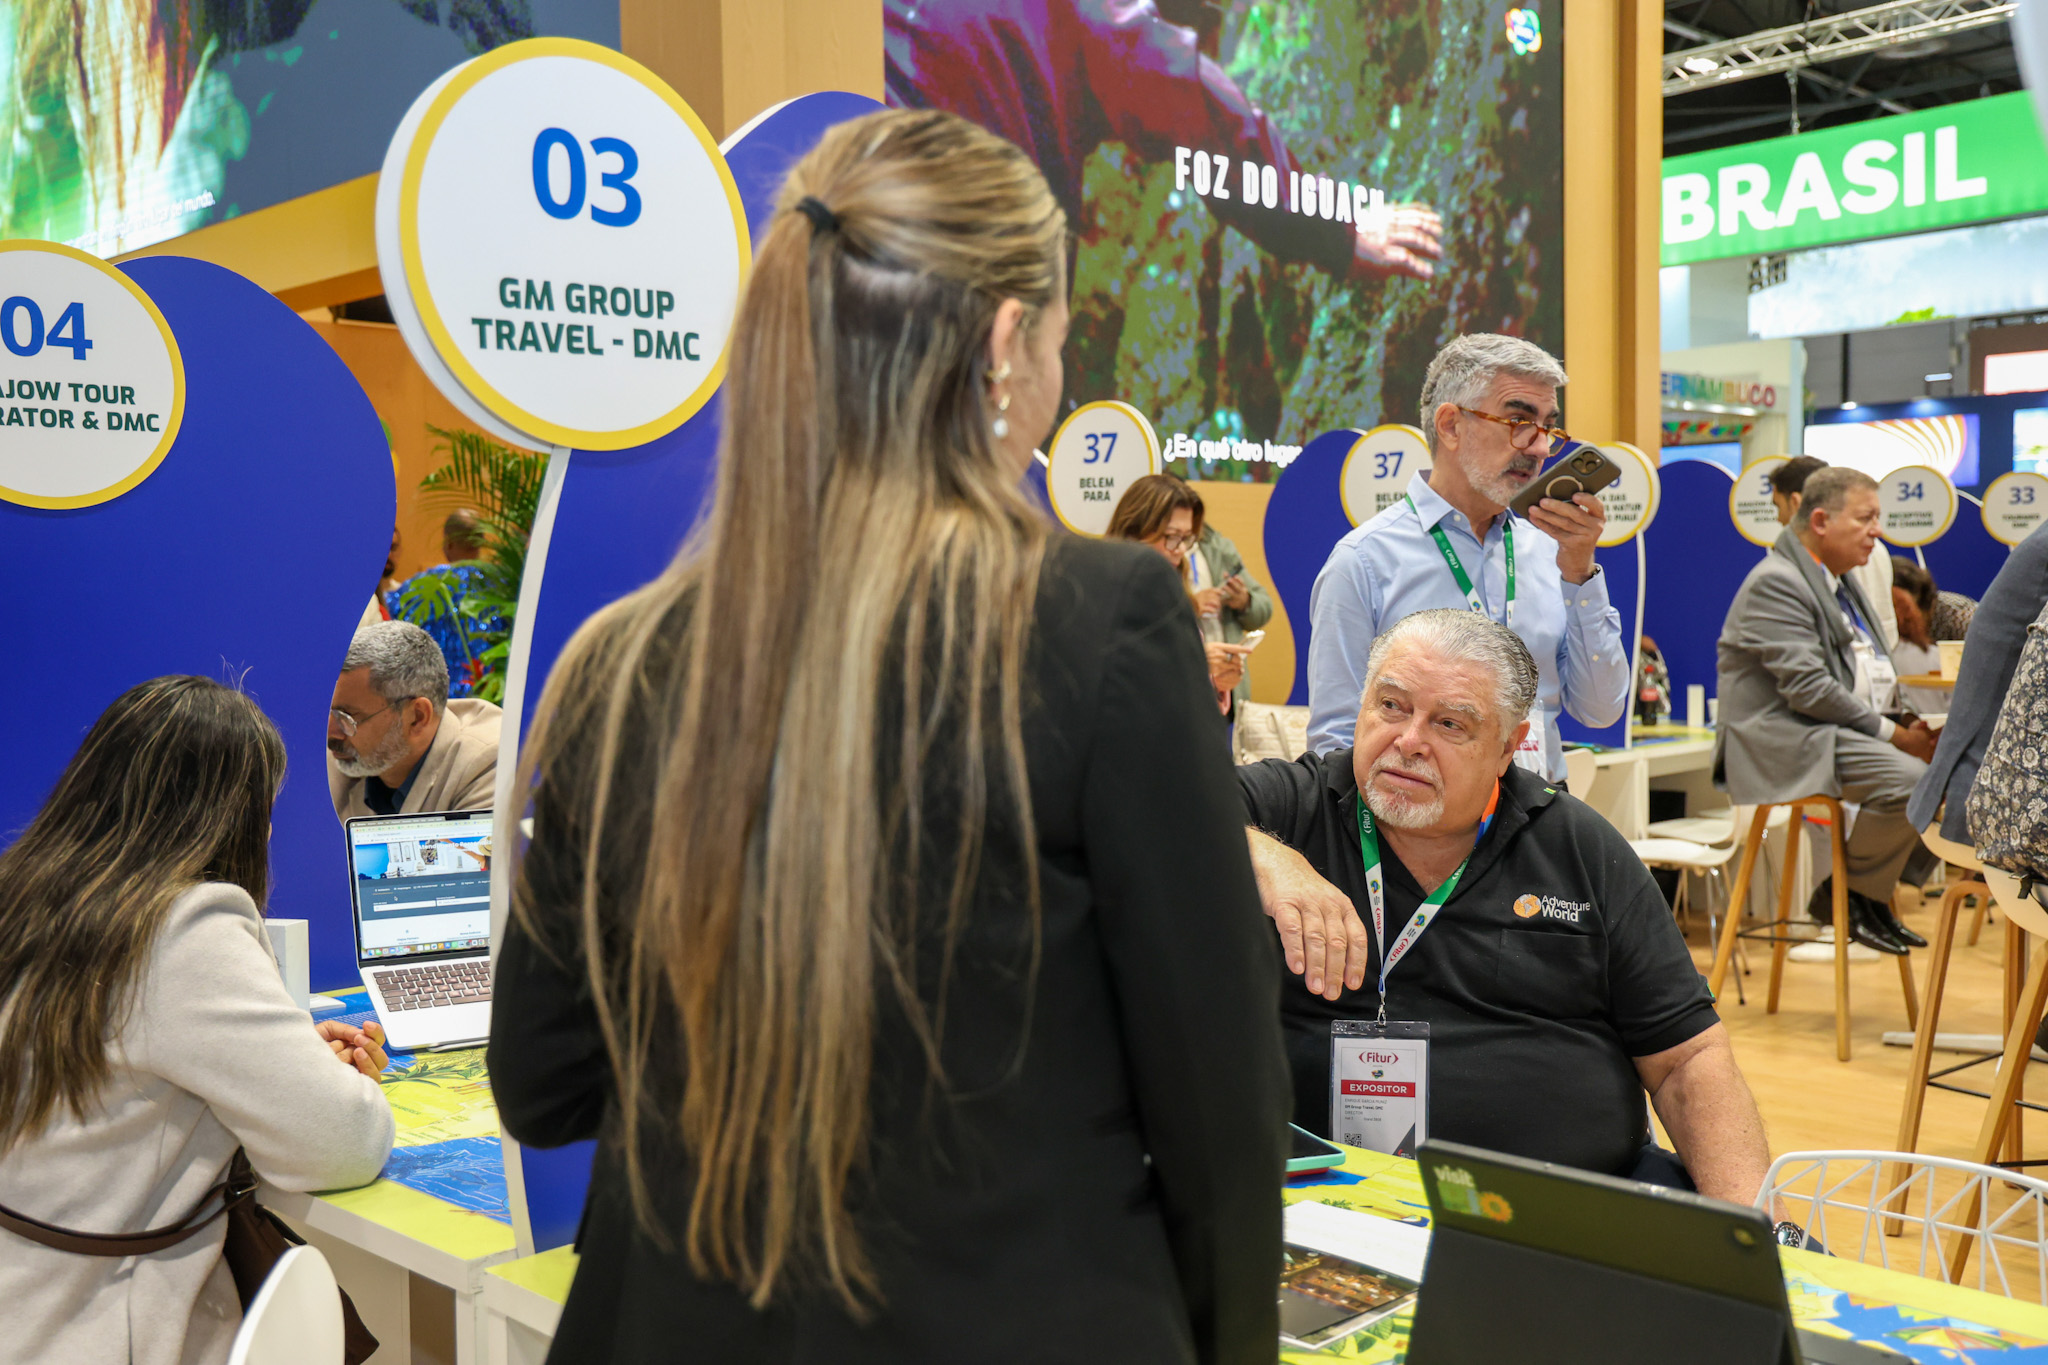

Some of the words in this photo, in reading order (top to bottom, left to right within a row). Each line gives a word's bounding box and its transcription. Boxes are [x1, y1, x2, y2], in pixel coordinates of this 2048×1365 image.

[532, 127, 642, 228] 03
[1175, 145, 1230, 200] FOZ
[1242, 160, 1279, 210] DO
[1661, 125, 1988, 246] BRASIL
[499, 277, 555, 312] GM
[565, 282, 676, 320] GROUP
[0, 296, 93, 361] 04
[471, 316, 605, 356] TRAVEL
[633, 328, 701, 361] DMC
[68, 382, 136, 405] TOUR
[1661, 373, 1776, 408] ERNAMBUCO
[82, 410, 100, 430] &
[107, 411, 160, 432] DMC
[1083, 432, 1118, 464] 37
[1163, 432, 1198, 463] ¿En
[1231, 439, 1263, 463] otro
[1374, 451, 1404, 479] 37
[1759, 474, 1774, 495] 3
[1896, 481, 1924, 502] 34
[2009, 486, 2035, 505] 33
[1541, 895, 1591, 911] Adventure
[1541, 904, 1579, 922] World
[1349, 1083, 1407, 1094] EXPOSITOR
[1433, 1165, 1475, 1188] visit
